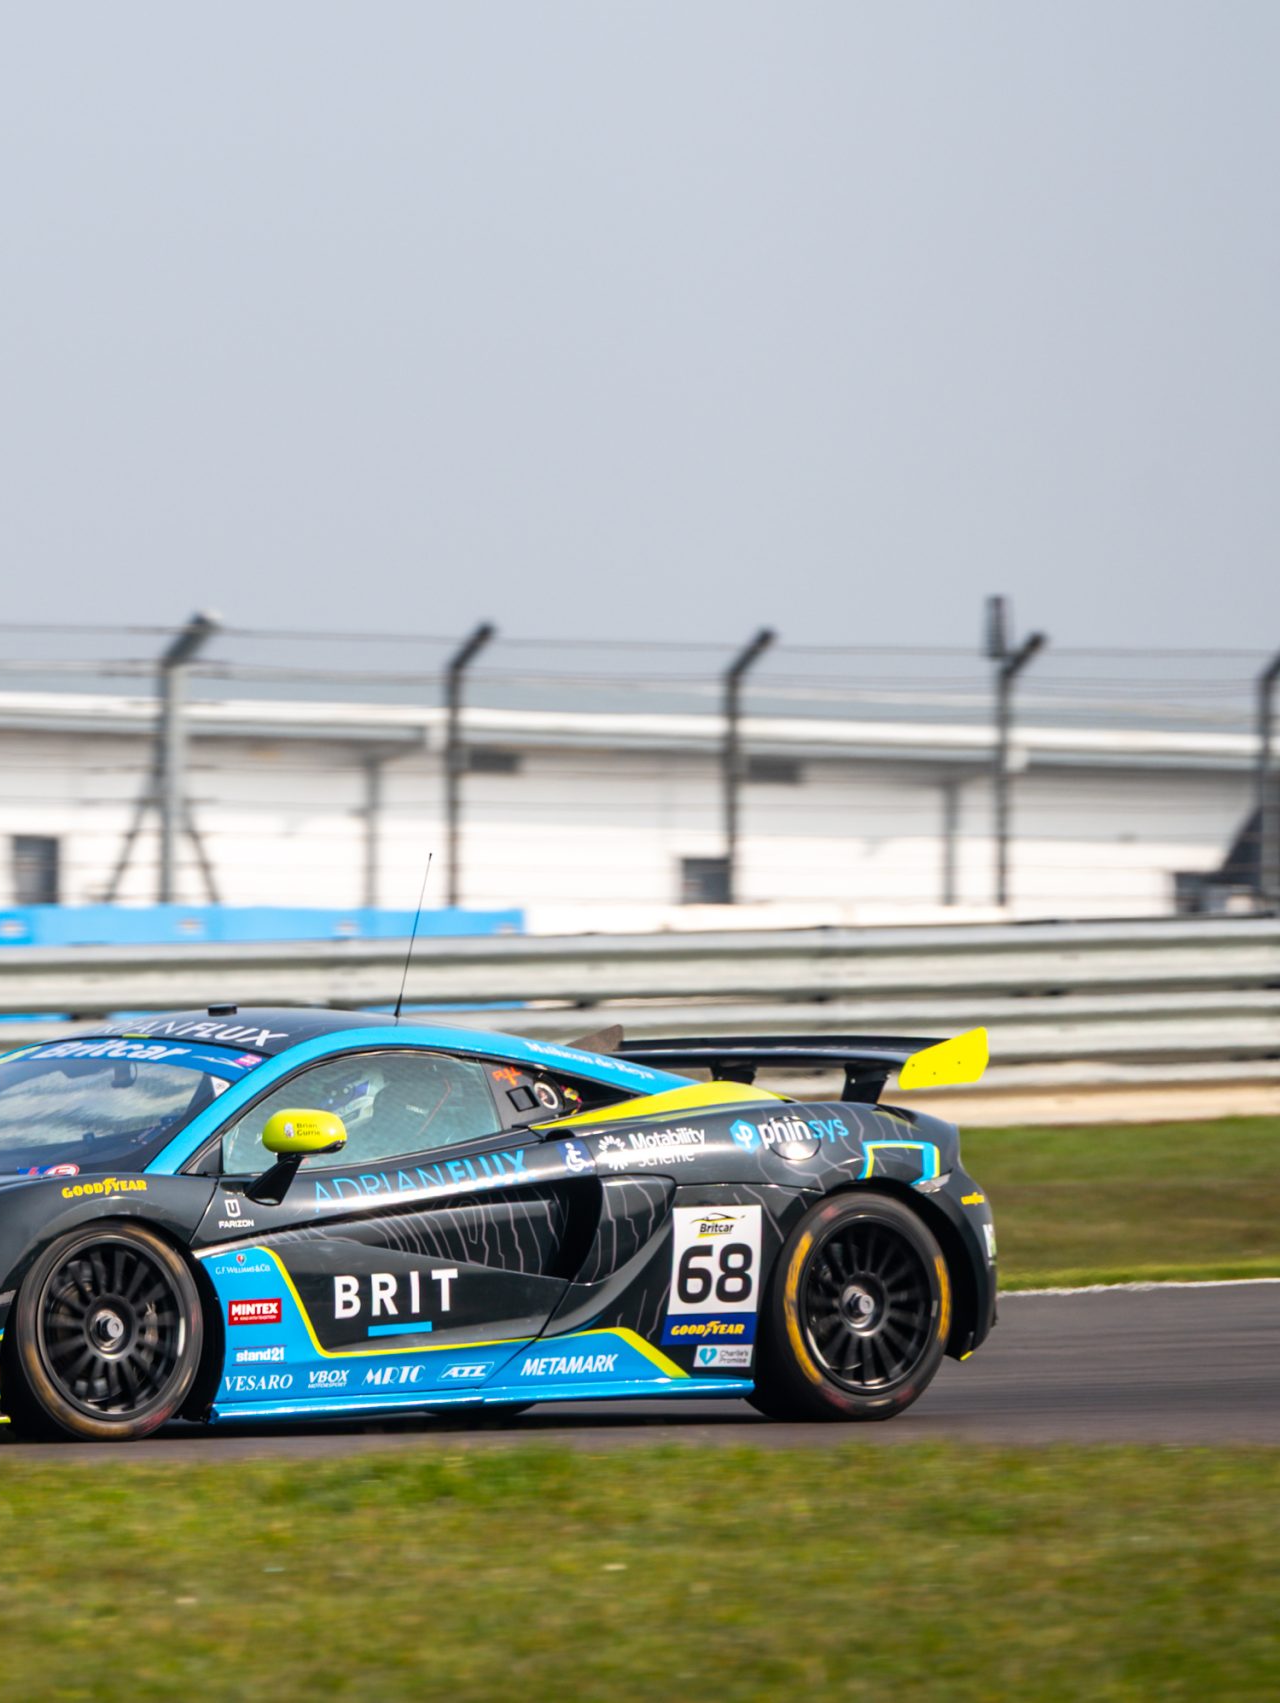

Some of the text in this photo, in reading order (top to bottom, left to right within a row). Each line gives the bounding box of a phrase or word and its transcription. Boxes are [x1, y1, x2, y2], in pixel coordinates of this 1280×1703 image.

[30, 1038, 192, 1060] Britcar
[628, 1126, 706, 1150] Motability
[757, 1116, 849, 1149] phinsys
[61, 1177, 147, 1198] GOODYEAR
[218, 1219, 255, 1229] FARIZON
[699, 1223, 734, 1233] Britcar
[677, 1242, 753, 1304] 68
[333, 1268, 459, 1320] BRIT
[231, 1302, 279, 1316] MINTEX
[671, 1320, 745, 1337] GOODYEAR
[236, 1347, 285, 1363] stand21
[520, 1354, 619, 1377] METAMARK
[224, 1374, 294, 1391] VESARO
[308, 1369, 350, 1383] VBOX
[361, 1365, 426, 1386] MRTC
